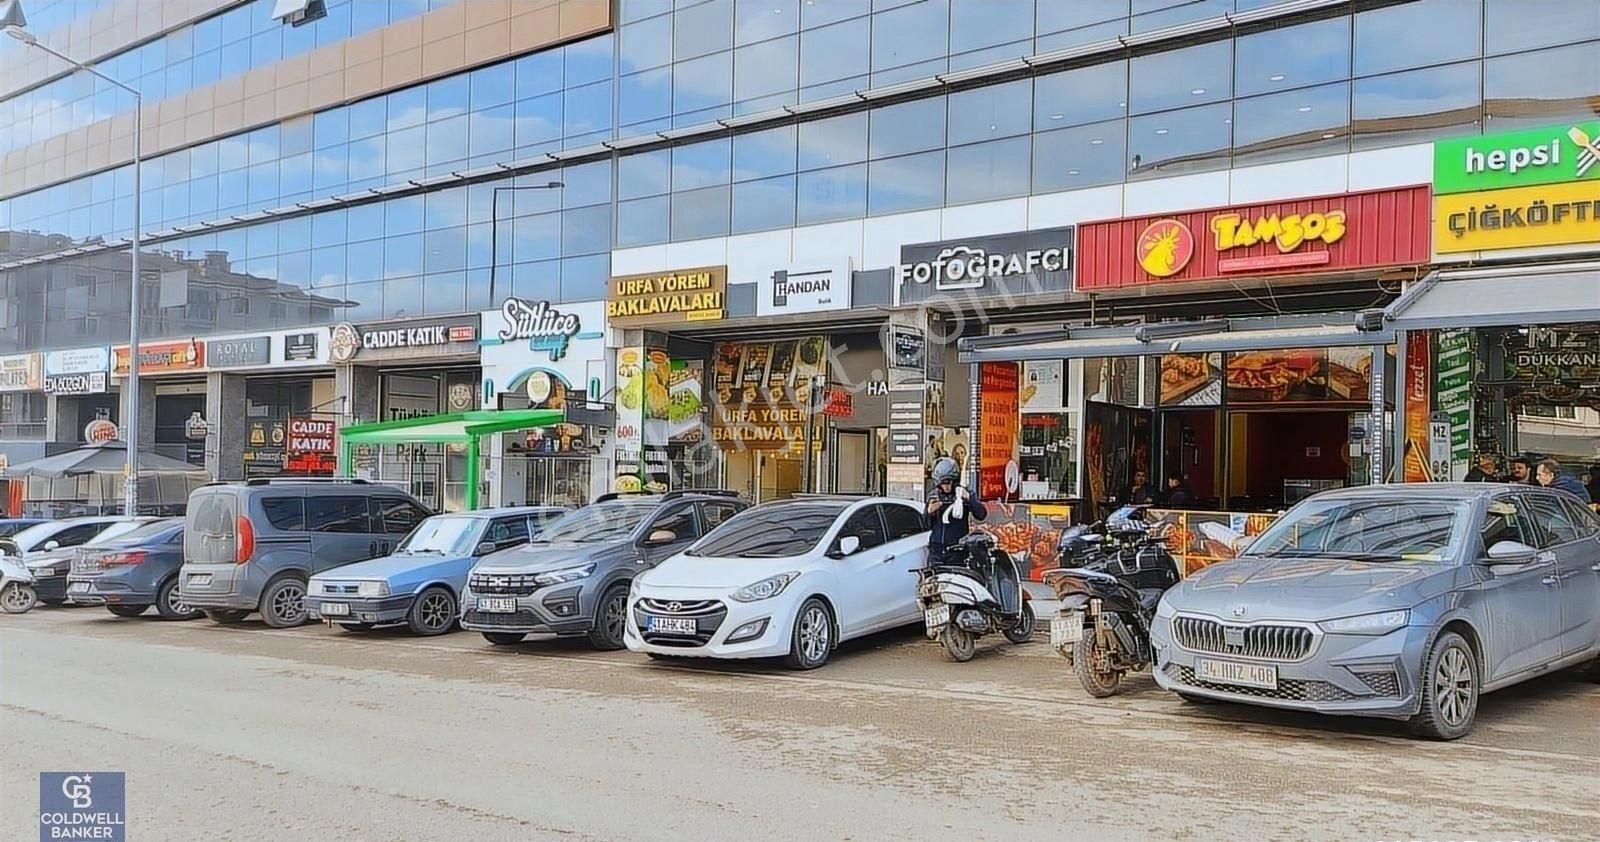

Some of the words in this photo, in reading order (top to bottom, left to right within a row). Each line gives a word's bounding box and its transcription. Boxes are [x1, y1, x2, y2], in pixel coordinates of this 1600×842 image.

[1466, 138, 1560, 174] hepsi
[1210, 209, 1346, 253] TAMSOS
[900, 247, 1070, 285] FOTOĞRAFÇI
[616, 279, 653, 296] URFA
[658, 272, 711, 292] YÖREM
[778, 279, 830, 295] HANDAN
[608, 291, 722, 317] BAKLAVALARI
[499, 297, 579, 341] Sütlüce
[363, 328, 406, 348] CADDE
[407, 325, 446, 346] KATIK
[1518, 351, 1597, 366] DÜKKAN
[1409, 361, 1426, 402] lezzet
[291, 421, 333, 434] CADDE
[722, 410, 757, 422] URFA
[292, 437, 331, 450] KATIK
[713, 425, 821, 441] BAKLAVALAI
[1202, 661, 1217, 677] 34
